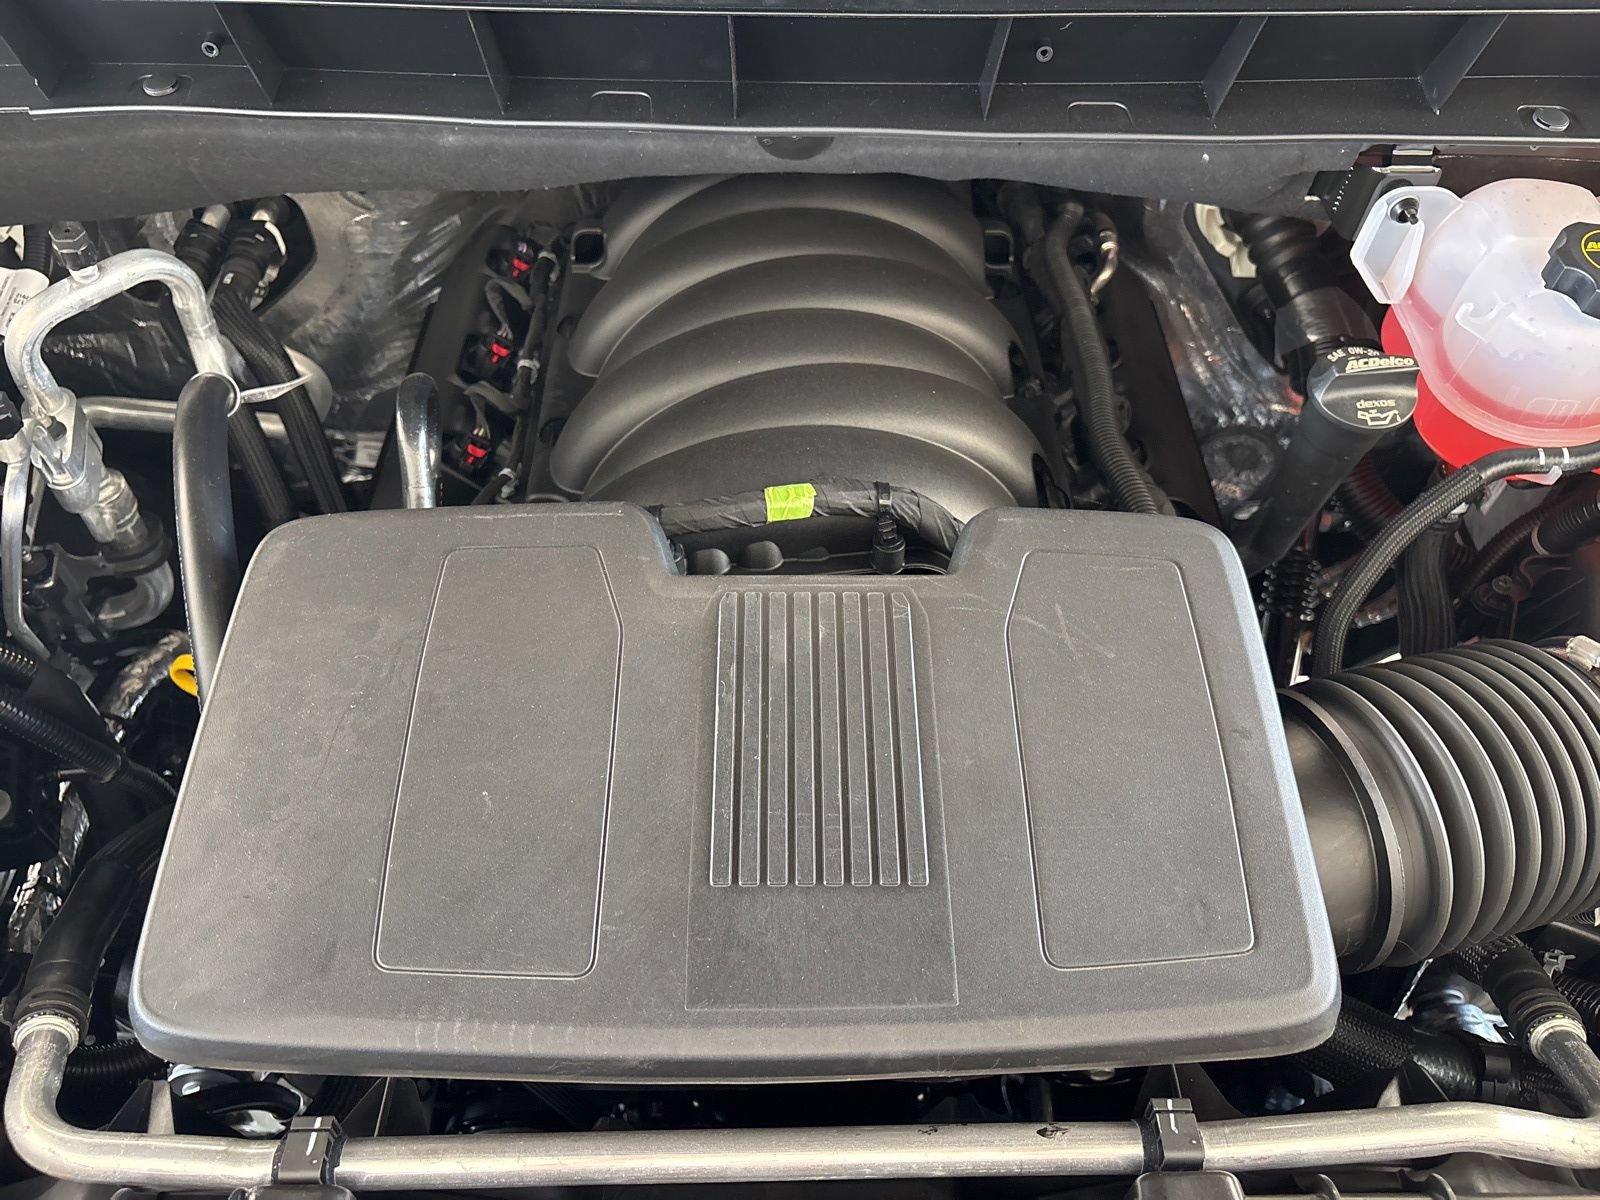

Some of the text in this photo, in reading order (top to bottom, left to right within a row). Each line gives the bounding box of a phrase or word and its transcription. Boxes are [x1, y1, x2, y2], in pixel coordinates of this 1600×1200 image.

[1327, 348, 1347, 362] SAE
[1345, 356, 1414, 371] ACDelco
[1356, 400, 1396, 409] dexos
